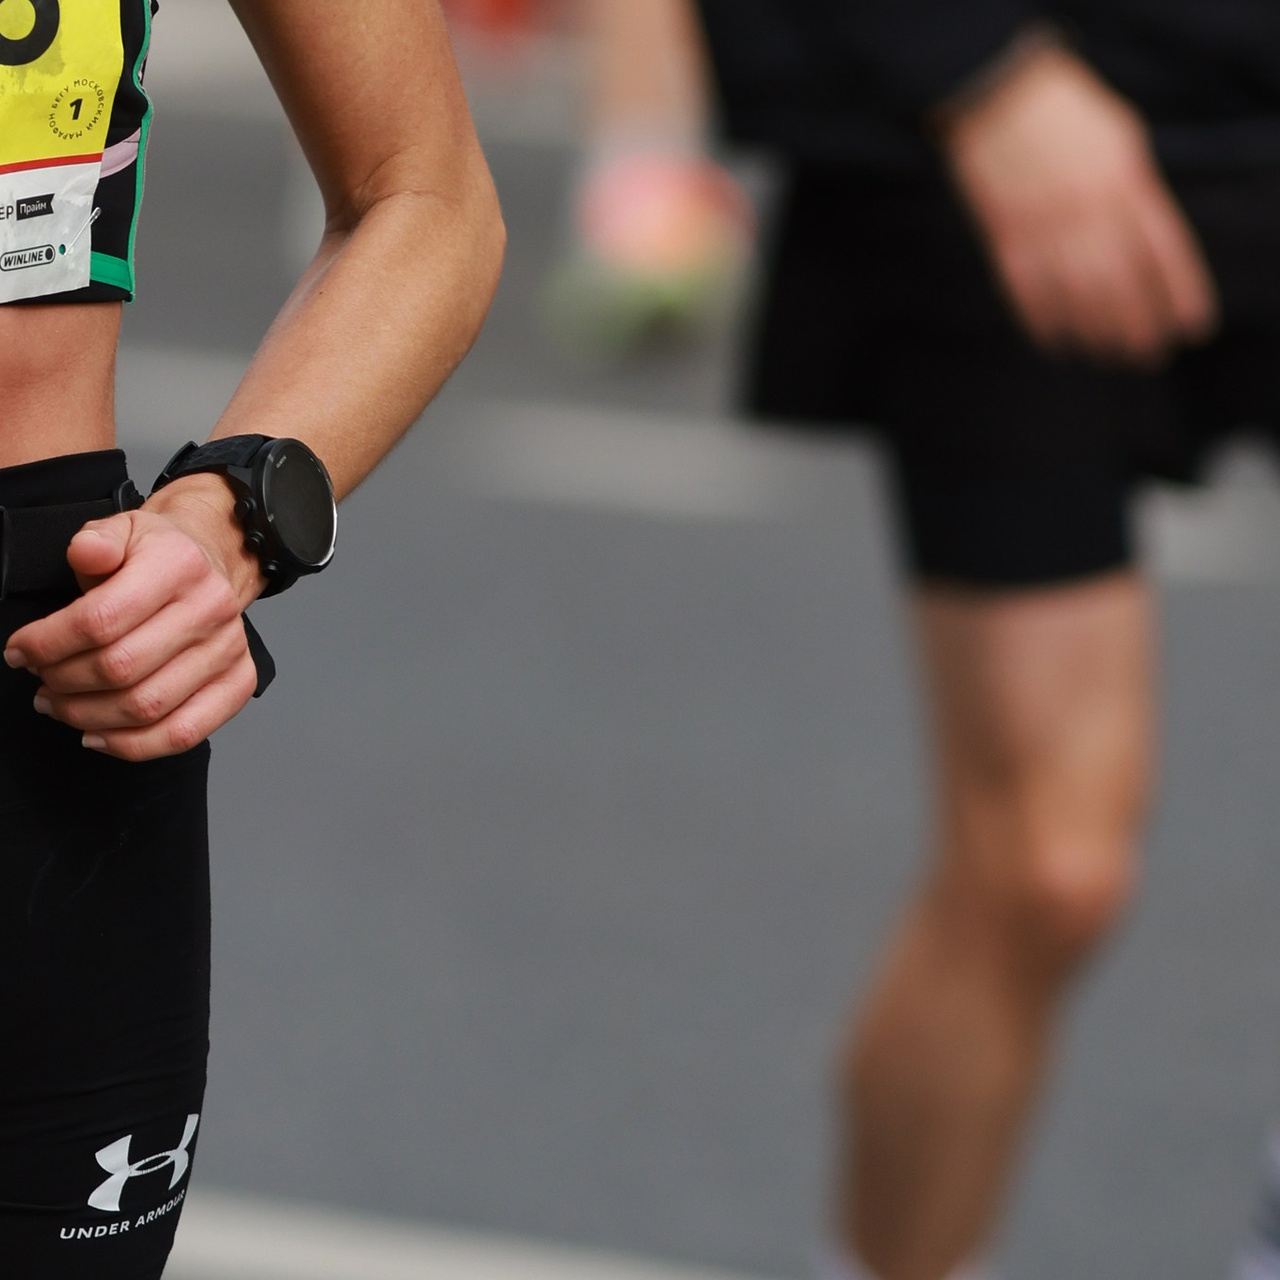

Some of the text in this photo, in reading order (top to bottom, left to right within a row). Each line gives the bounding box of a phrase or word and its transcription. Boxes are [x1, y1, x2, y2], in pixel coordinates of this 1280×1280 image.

[69, 98, 83, 120] 1
[19, 200, 47, 215] Прайм
[3, 250, 44, 267] WINLINE
[60, 1221, 130, 1240] UNDER
